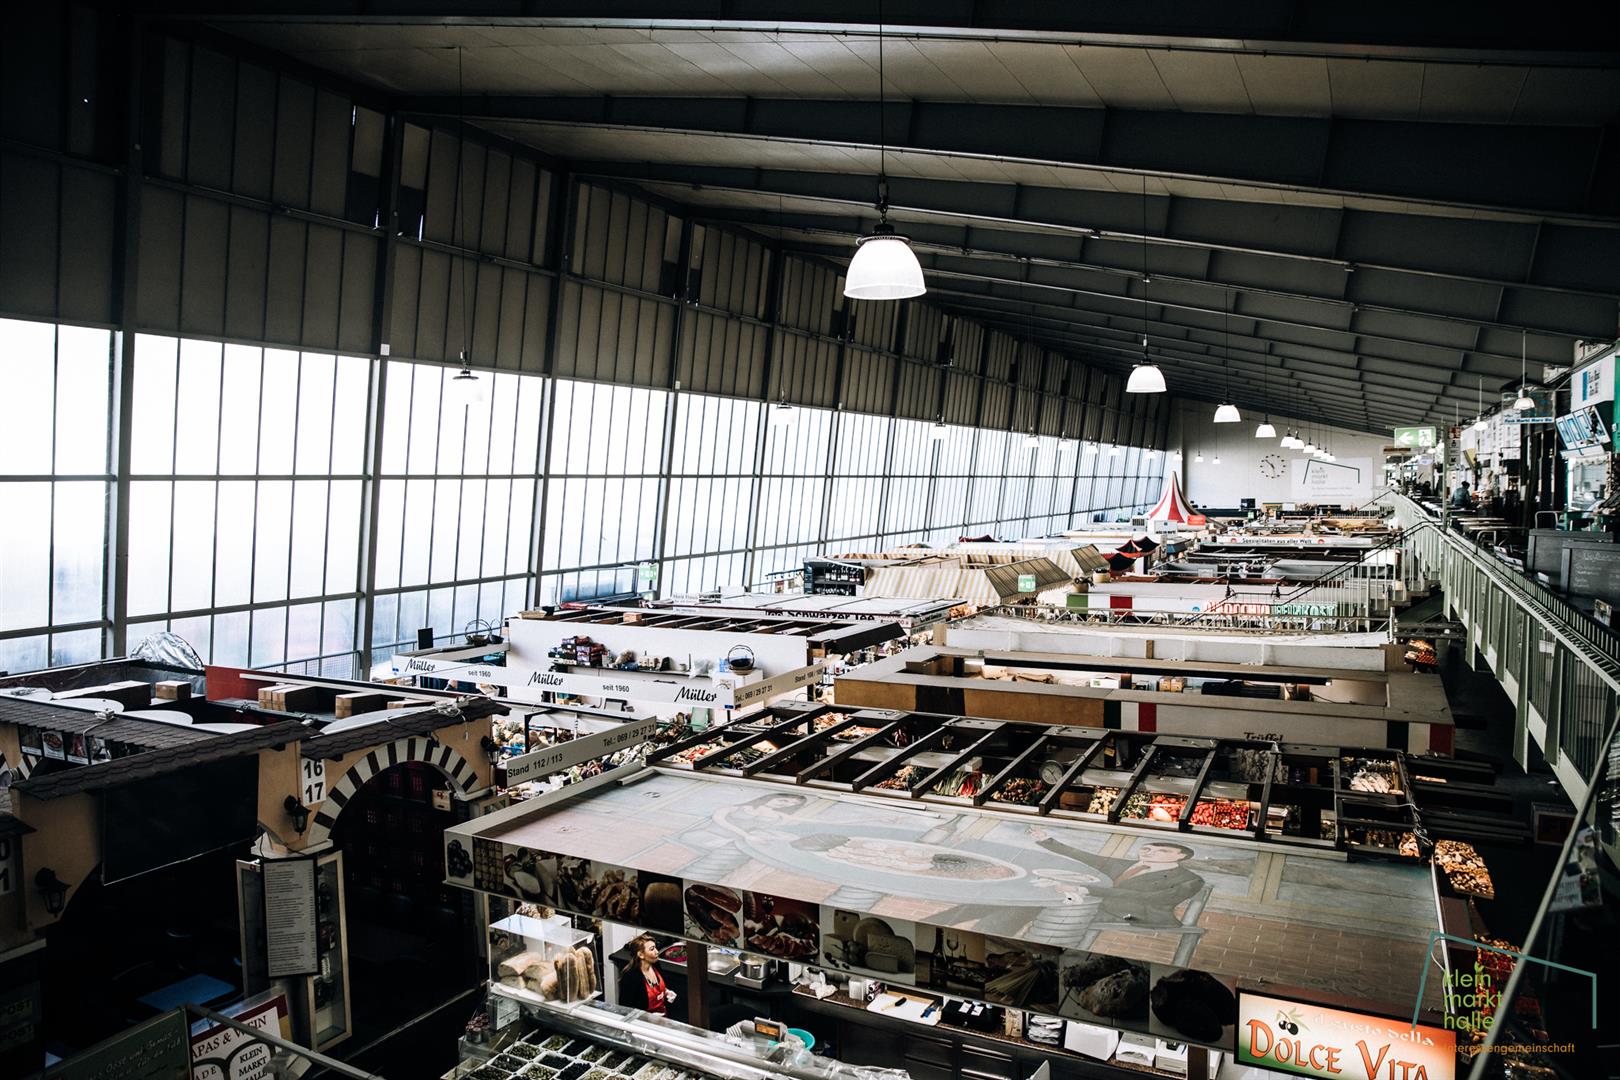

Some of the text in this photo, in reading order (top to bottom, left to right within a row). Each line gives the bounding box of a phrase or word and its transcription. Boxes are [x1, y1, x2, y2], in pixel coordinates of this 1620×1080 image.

[404, 658, 436, 672] Müller
[527, 671, 564, 687] Müller
[602, 684, 630, 693] seit 1960
[674, 686, 718, 702] Müller
[507, 764, 530, 778] Stand
[533, 757, 546, 770] 112
[551, 753, 563, 765] 113
[603, 738, 614, 747] Tel.:
[616, 732, 628, 744] 069
[632, 730, 640, 738] 29
[640, 728, 647, 736] 27
[648, 724, 655, 734] 31
[304, 760, 323, 779] 16
[305, 782, 324, 803] 17
[191, 1037, 219, 1059] APAS
[222, 1032, 232, 1045] &
[1387, 1028, 1435, 1047] della
[240, 1046, 263, 1063] KLEIN
[1246, 1018, 1429, 1080] DOLCE VITA
[238, 1056, 268, 1077] MARKT
